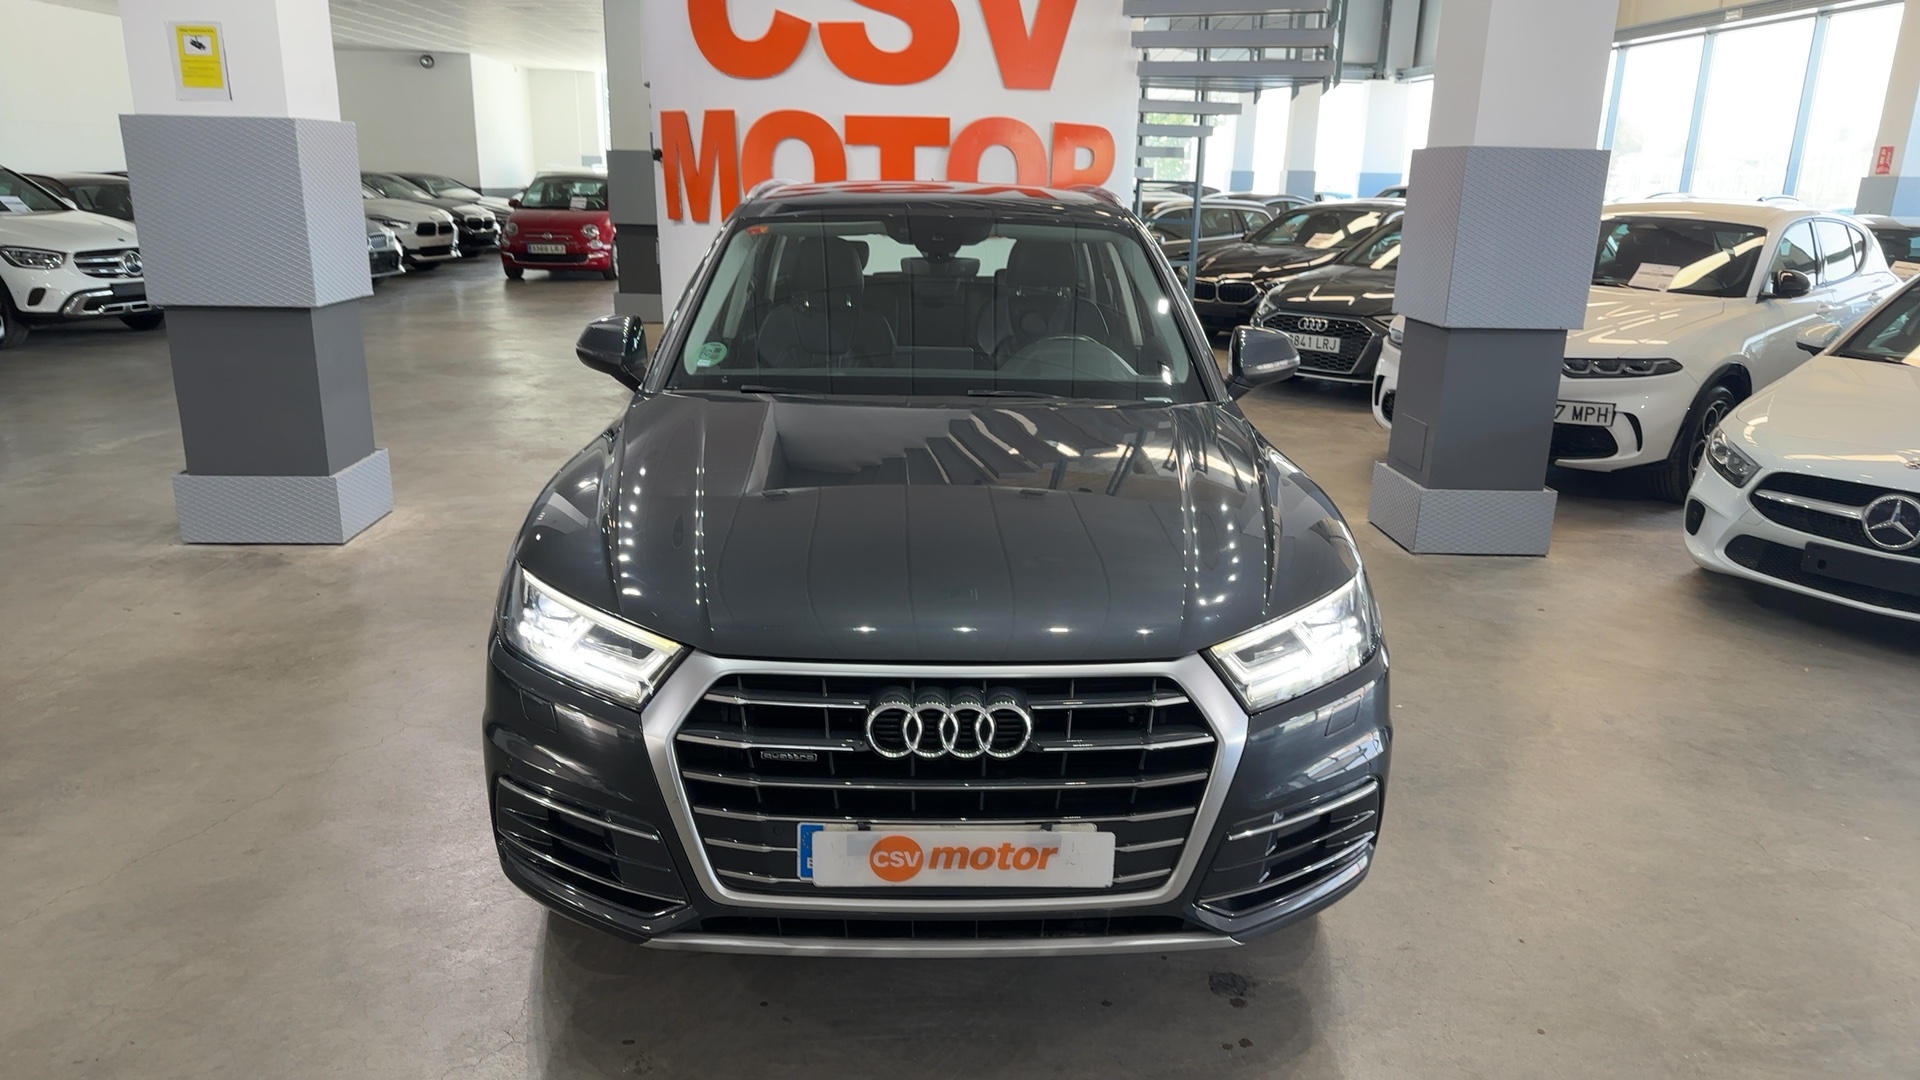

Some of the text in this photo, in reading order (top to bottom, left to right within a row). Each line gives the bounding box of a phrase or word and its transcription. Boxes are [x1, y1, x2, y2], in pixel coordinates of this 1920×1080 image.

[660, 109, 1116, 224] MOTOR
[1289, 334, 1337, 351] 841 LRJ
[1571, 405, 1609, 423] MPH
[763, 752, 815, 760] quattro
[872, 842, 1059, 871] CSV motor
